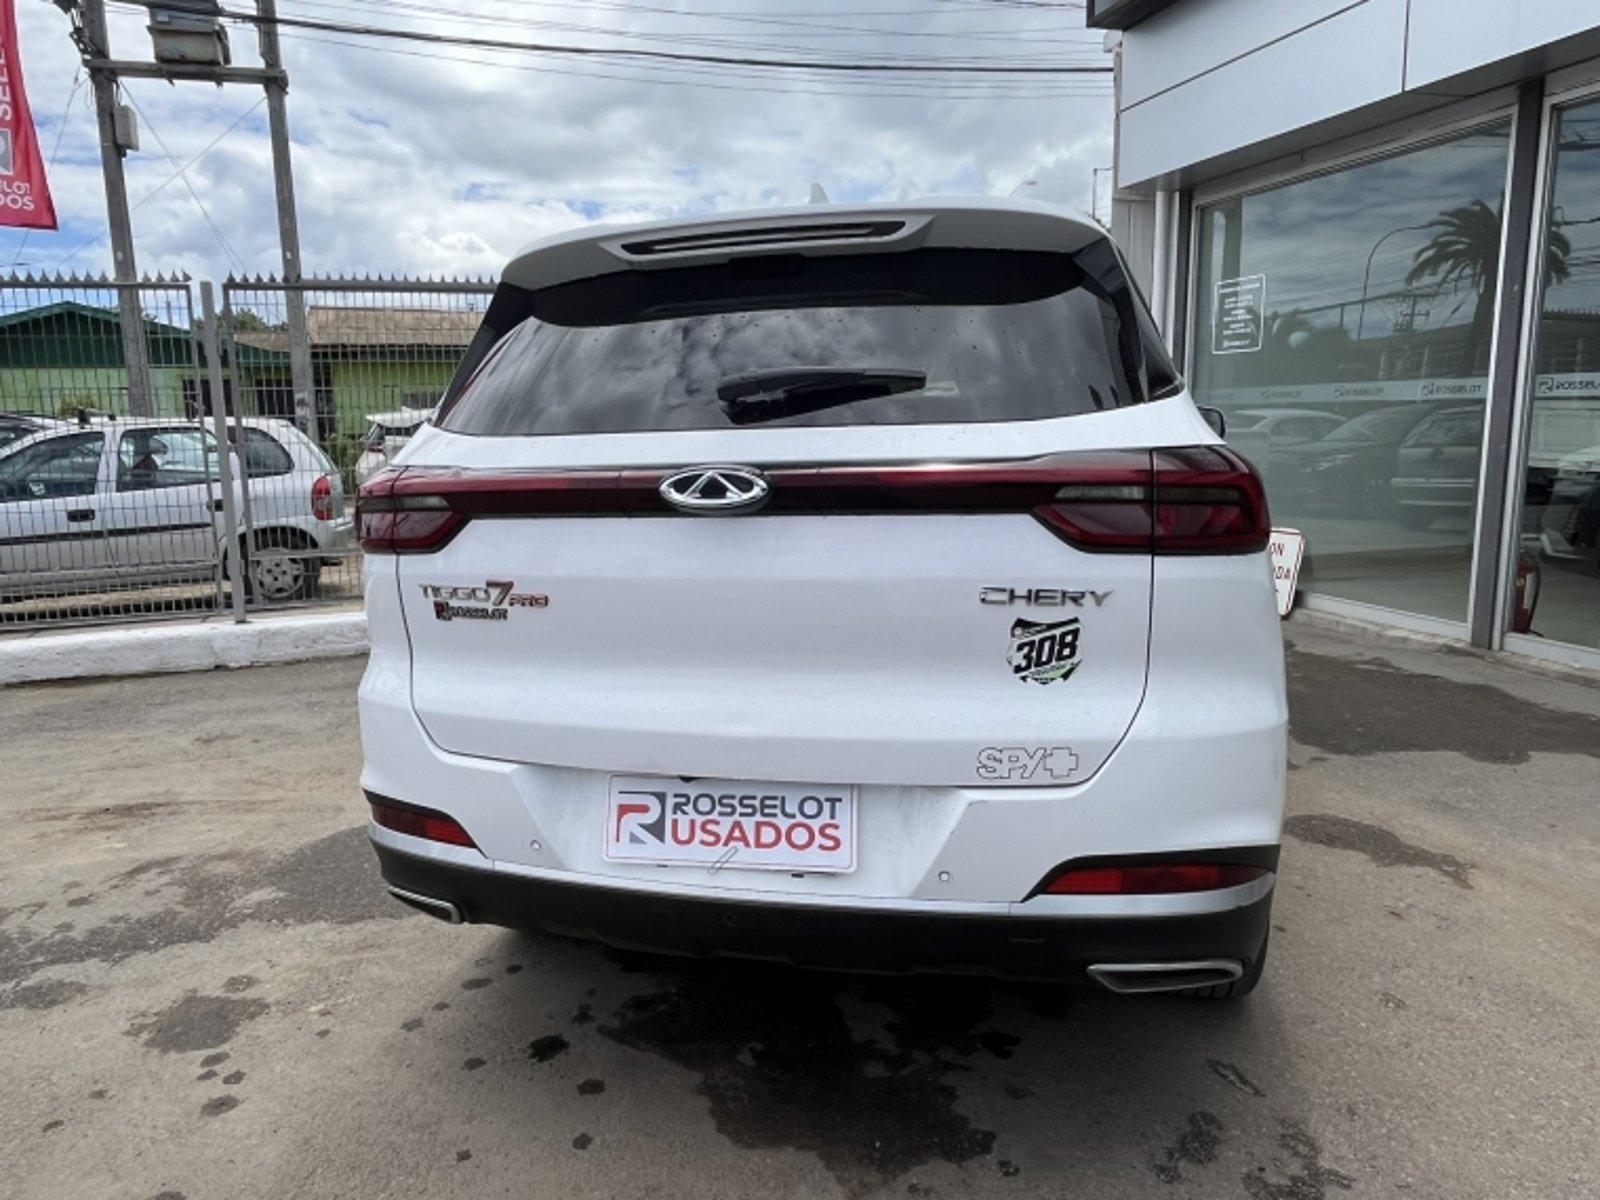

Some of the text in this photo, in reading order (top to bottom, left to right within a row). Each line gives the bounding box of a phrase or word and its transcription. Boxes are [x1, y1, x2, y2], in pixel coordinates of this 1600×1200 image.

[418, 580, 549, 607] TIGGO 7 PRO
[979, 586, 1114, 607] CHERY
[1013, 627, 1081, 674] 308
[672, 793, 843, 820] ROSSELOT
[671, 818, 843, 851] USADOS
